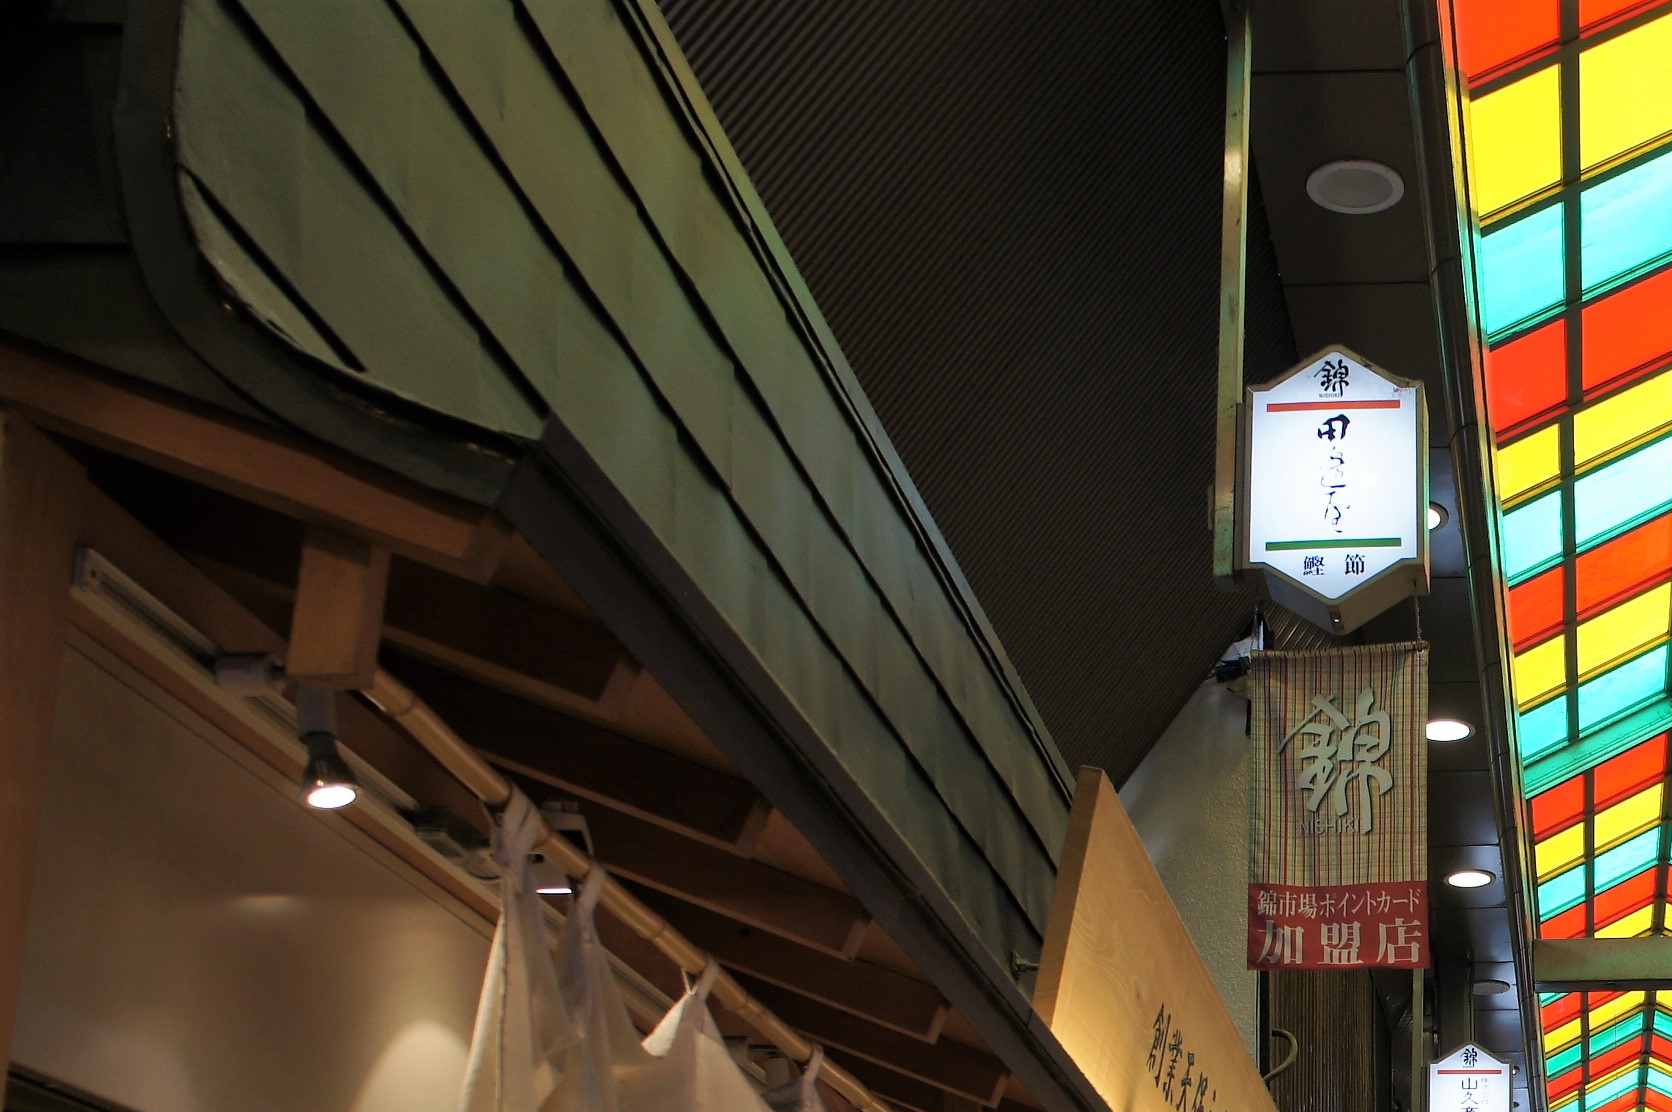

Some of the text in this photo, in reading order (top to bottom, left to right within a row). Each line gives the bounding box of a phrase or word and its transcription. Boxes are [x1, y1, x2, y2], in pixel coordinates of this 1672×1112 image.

[1314, 358, 1349, 397] 錦
[1303, 554, 1366, 576] 鰹節
[1278, 687, 1393, 834] 錦
[1300, 819, 1360, 834] NISHIKI
[1257, 888, 1421, 919] 錦市場ポイントカード
[1257, 919, 1422, 965] 加盟店
